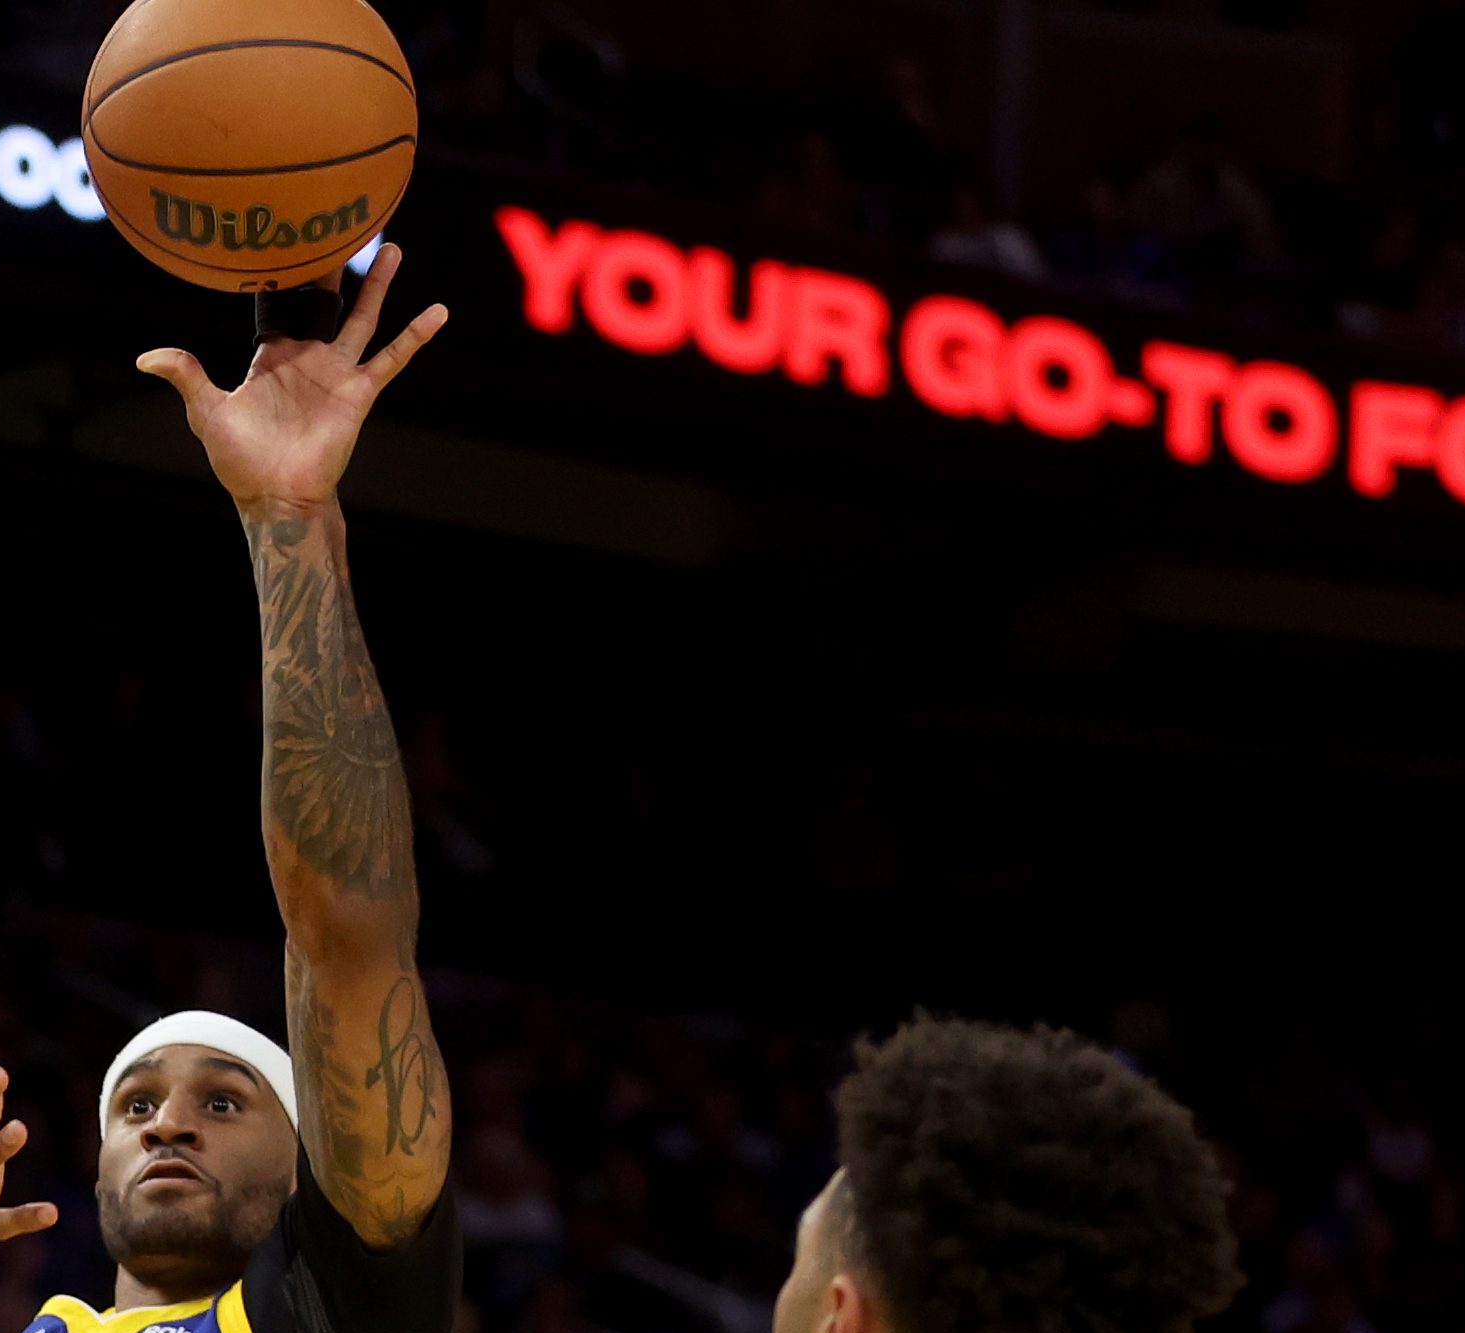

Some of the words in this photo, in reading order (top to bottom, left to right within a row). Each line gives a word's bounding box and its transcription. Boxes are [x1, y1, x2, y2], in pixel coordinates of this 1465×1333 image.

[149, 187, 371, 252] Wilson
[494, 204, 891, 398] YOUR
[899, 294, 1339, 484] GO-TO
